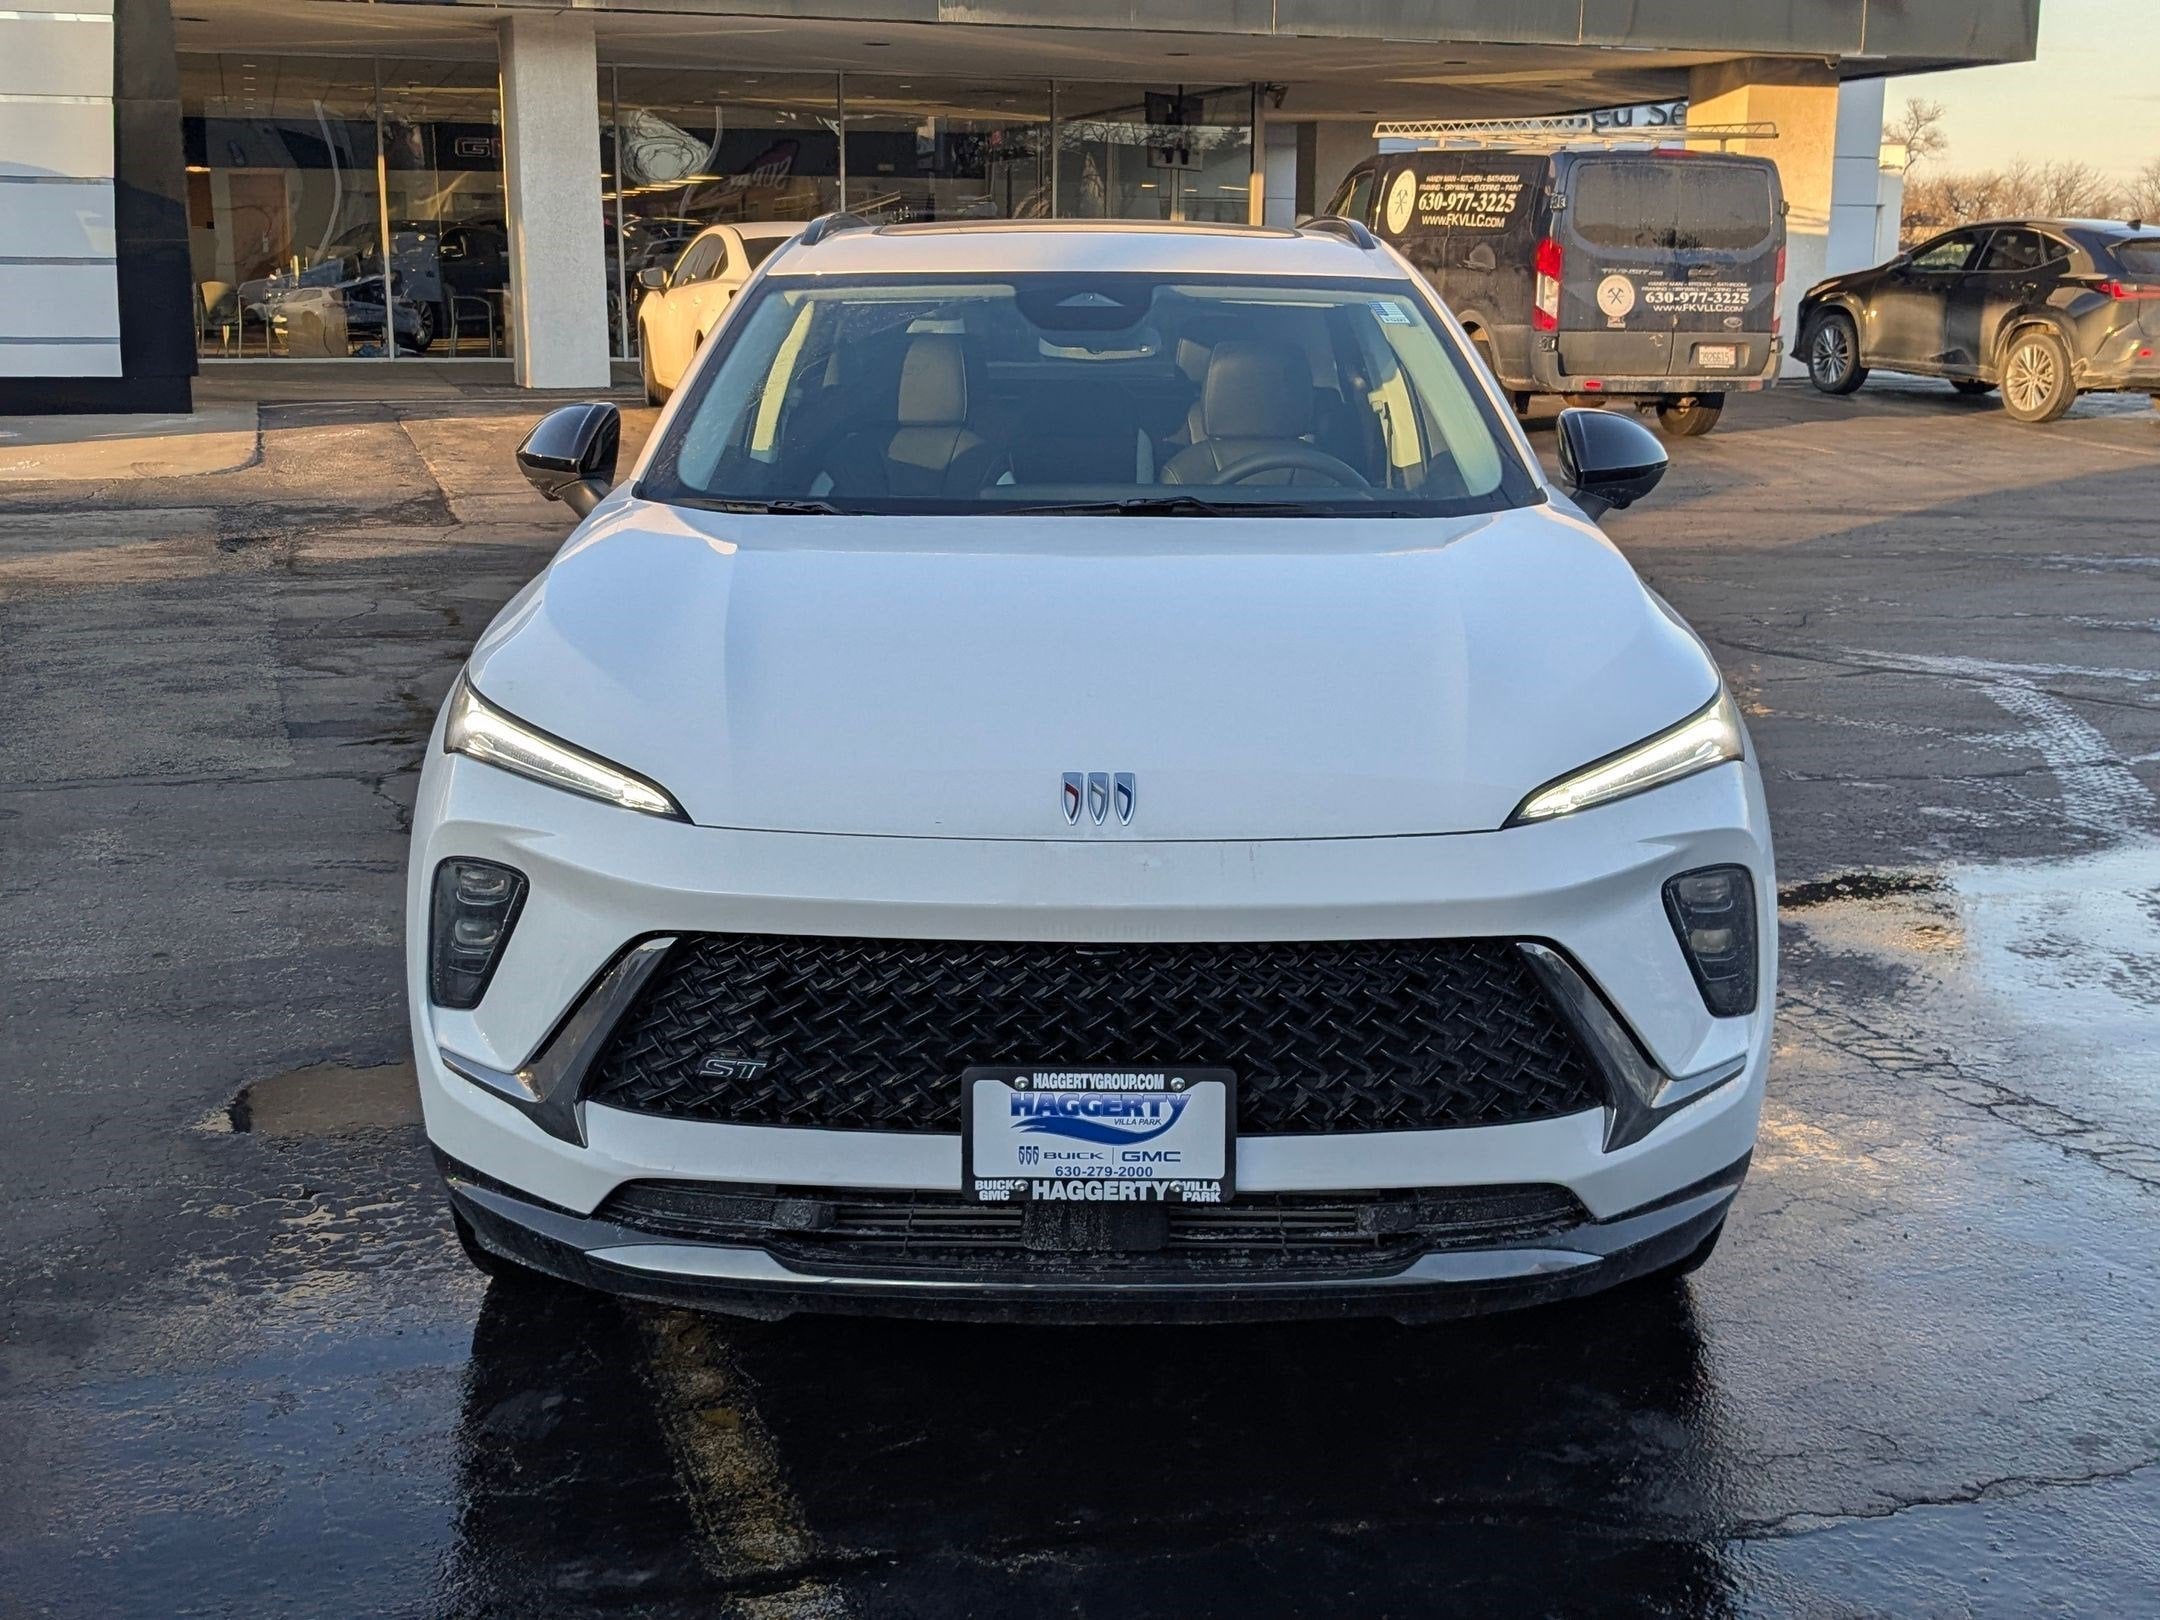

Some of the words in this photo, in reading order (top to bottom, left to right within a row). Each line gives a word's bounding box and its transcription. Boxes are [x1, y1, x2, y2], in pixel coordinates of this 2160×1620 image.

[1460, 174, 1483, 183] KITCHEN
[1487, 174, 1520, 183] BATHROOM
[1473, 183, 1501, 192] FLOORING
[1418, 192, 1517, 213] 630-977-3225
[1645, 291, 1750, 305] 630-977-3225
[700, 1059, 768, 1079] ST
[1033, 1072, 1165, 1090] HAGGERTYGROUP.COM
[1010, 1092, 1192, 1118] HAGGERTY
[1113, 1118, 1138, 1126] VILLA
[1138, 1118, 1162, 1126] PARK
[1043, 1152, 1105, 1160] BUICK
[1121, 1151, 1182, 1162] GMC
[1055, 1166, 1154, 1177] 630-279-2000
[974, 1180, 1016, 1191] BUICK
[1032, 1180, 1170, 1201] HAGGERTY
[1182, 1180, 1221, 1192] VILLA
[978, 1190, 1011, 1201] GMC
[1182, 1191, 1221, 1202] PARK
